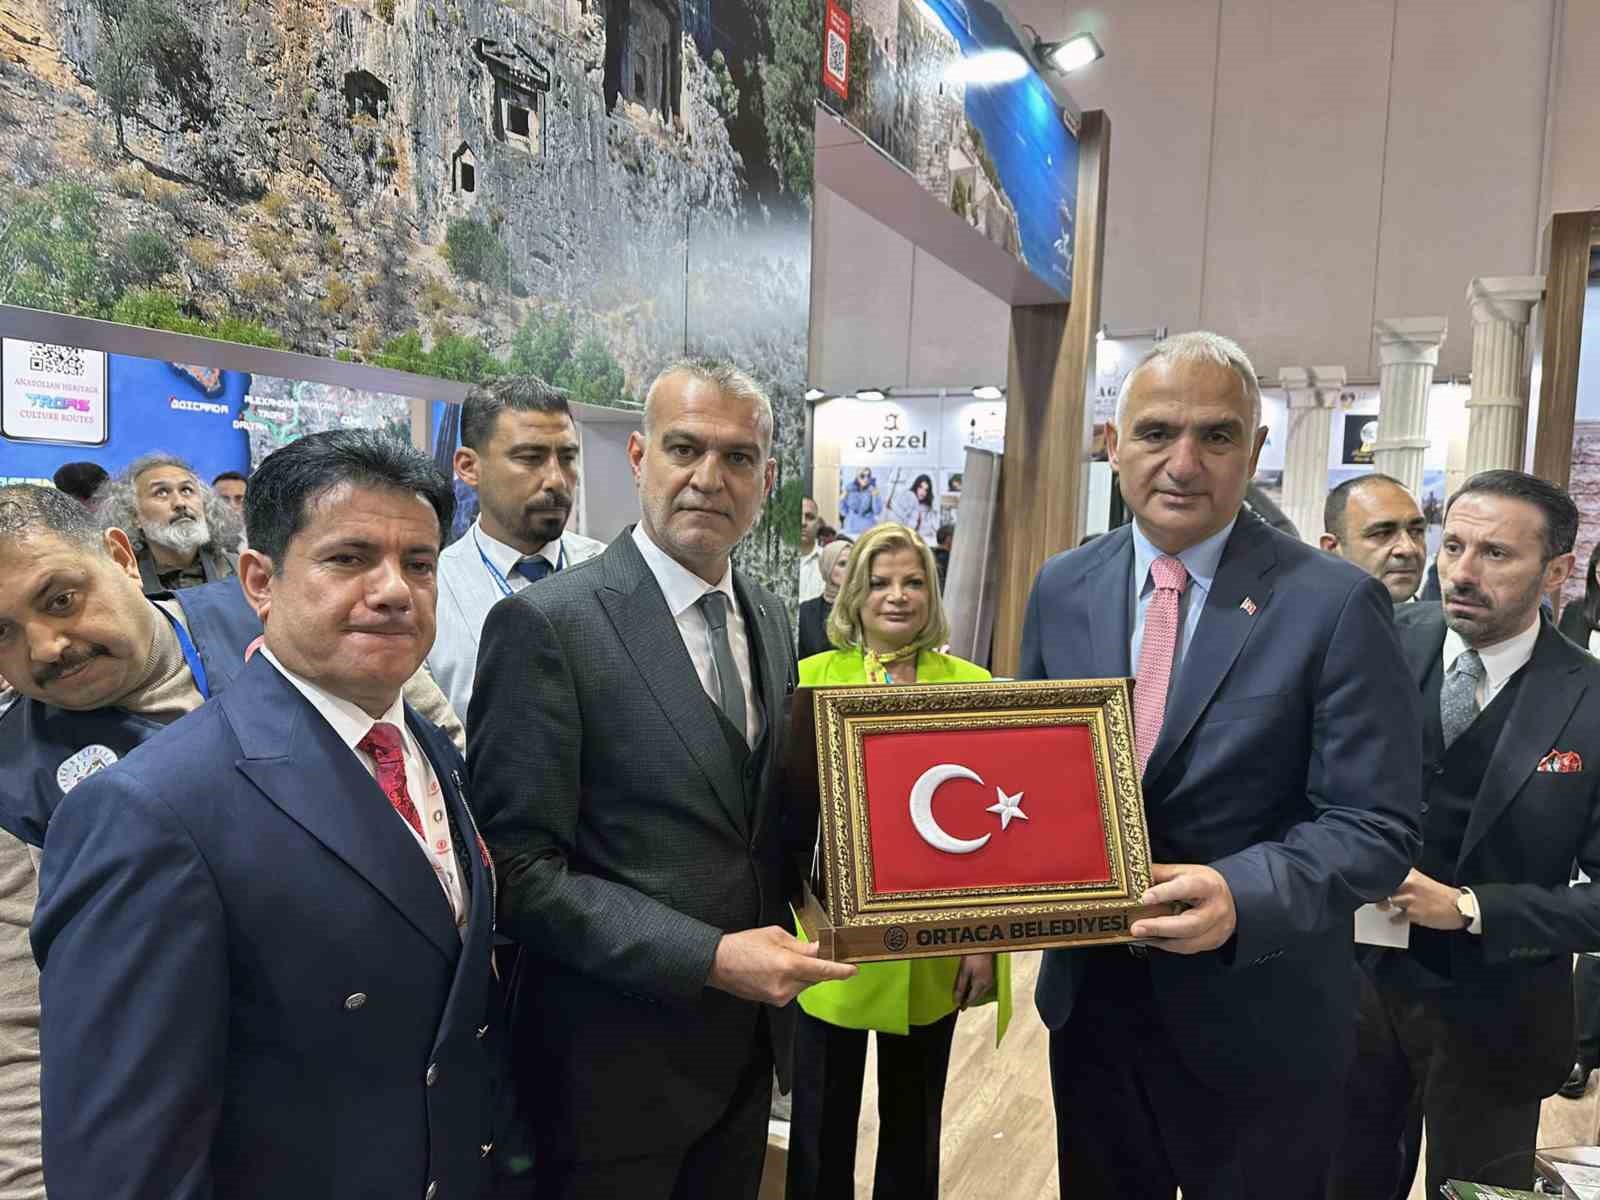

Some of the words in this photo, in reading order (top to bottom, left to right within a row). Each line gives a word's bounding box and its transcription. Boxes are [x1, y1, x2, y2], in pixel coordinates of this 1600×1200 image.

[19, 408, 60, 421] CULTURE
[61, 413, 96, 424] ROUTES
[855, 430, 928, 453] ayazel
[916, 926, 1004, 946] ORTACA
[1009, 912, 1129, 939] BELEDİYESİ
